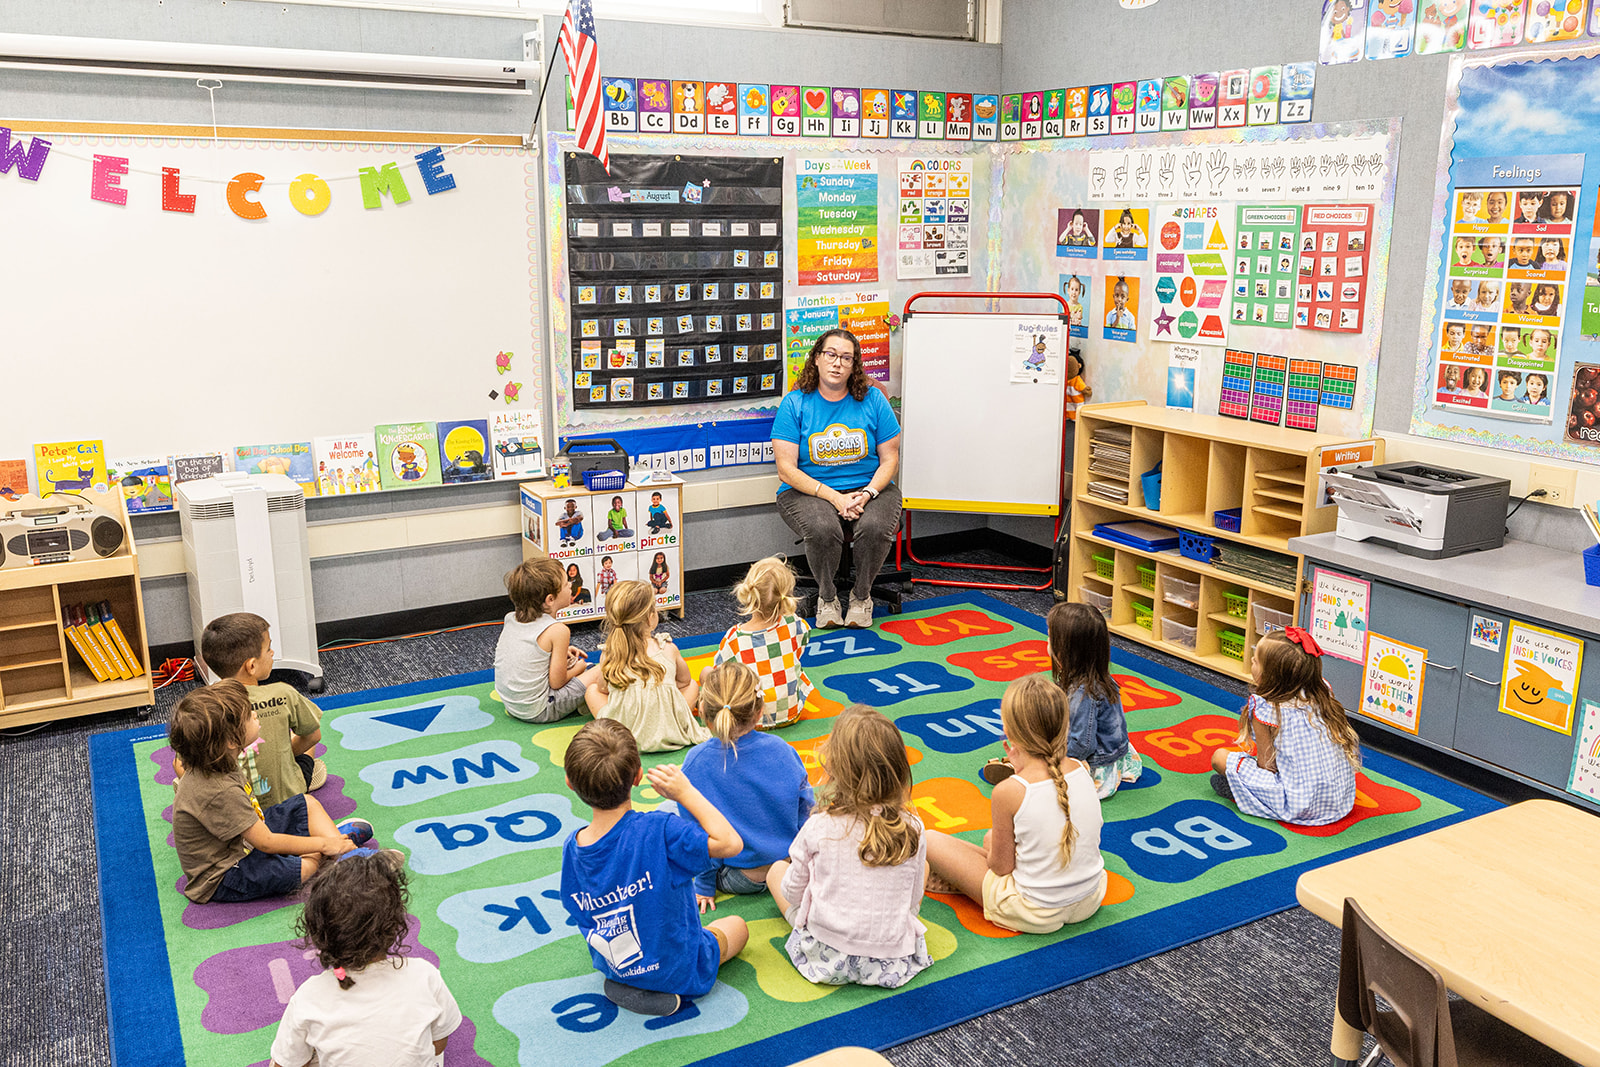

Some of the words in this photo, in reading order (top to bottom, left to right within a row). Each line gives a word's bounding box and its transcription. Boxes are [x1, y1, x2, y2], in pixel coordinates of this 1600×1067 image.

[1224, 108, 1239, 121] Xx
[1255, 105, 1271, 121] Yy
[1287, 102, 1304, 117] Zz
[611, 112, 629, 126] Bb
[647, 114, 664, 127] Cc
[680, 115, 698, 128] Dd
[714, 116, 730, 128] Ee
[1117, 117, 1128, 128] Tt
[1140, 115, 1156, 127] Uu
[1167, 113, 1182, 125] Vv
[1192, 110, 1214, 123] Ww
[748, 117, 761, 129] Ff
[777, 118, 794, 133] Gg
[807, 119, 825, 131] Hh
[841, 120, 851, 132] Ii
[869, 121, 880, 135] Jj
[896, 122, 911, 133] Kk
[926, 123, 936, 134] Ll
[948, 123, 968, 135] Mm
[1045, 122, 1059, 136] Qq
[1070, 120, 1080, 132] Rr
[1093, 119, 1105, 131] Ss
[978, 125, 992, 136] Nn
[1004, 125, 1017, 136] Oo
[1025, 124, 1037, 136] Pp
[804, 160, 830, 172] Days
[844, 160, 871, 170] Week
[927, 160, 961, 170] COLORS
[0, 127, 456, 220] WELCOME
[1492, 165, 1541, 183] Feelings
[820, 176, 855, 188] Sunday
[646, 191, 671, 201] August
[818, 192, 857, 203] Monday
[818, 209, 858, 220] Tuesday
[1183, 207, 1217, 219] SHAPES
[811, 224, 865, 235] Wednesday
[815, 240, 860, 251] Thursday
[823, 256, 853, 267] Friday
[816, 271, 862, 282] Saturday
[1463, 268, 1489, 276] Surprised
[797, 295, 835, 307] Months
[855, 292, 878, 302] Year
[802, 310, 835, 321] January
[851, 307, 865, 315] July
[802, 323, 839, 333] February
[851, 318, 876, 328] August
[1018, 324, 1034, 333] Rug
[853, 330, 888, 342] eptember
[1452, 353, 1481, 362] Frustrated
[1507, 358, 1544, 368] Disappointed
[1452, 397, 1471, 405] Excited
[1511, 404, 1528, 412] Calm
[41, 446, 68, 457] Pete
[77, 444, 98, 454] Cat
[236, 448, 251, 457] Cool
[270, 446, 293, 454] School
[294, 444, 308, 453] Dog
[333, 442, 342, 450] All
[345, 441, 358, 449] Are
[817, 437, 860, 452] COUGARS
[329, 449, 364, 460] Welcome
[656, 459, 662, 467] 7
[669, 457, 675, 465] 8
[683, 455, 688, 464] 9
[694, 454, 704, 462] 10
[712, 451, 720, 459] 11
[725, 450, 734, 459] 12
[738, 449, 747, 457] 13
[751, 448, 760, 456] 14
[765, 447, 774, 455] 15
[1335, 450, 1360, 462] Writing
[177, 460, 189, 468] On
[596, 541, 636, 553] triangles
[640, 534, 676, 549] pirate
[549, 547, 594, 559] mountain
[1318, 581, 1329, 591] We
[1332, 584, 1349, 597] keep
[1352, 590, 1364, 598] our
[556, 609, 571, 618] riss
[572, 607, 594, 616] cross
[1316, 607, 1331, 616] and
[1315, 618, 1333, 632] FEET
[1516, 635, 1530, 644] We
[1534, 642, 1550, 650] use
[1554, 647, 1571, 655] our
[868, 673, 941, 694] Tt
[1369, 669, 1384, 681] We
[1388, 679, 1414, 692] work
[391, 751, 520, 789] Ww
[1131, 816, 1253, 859] Bb
